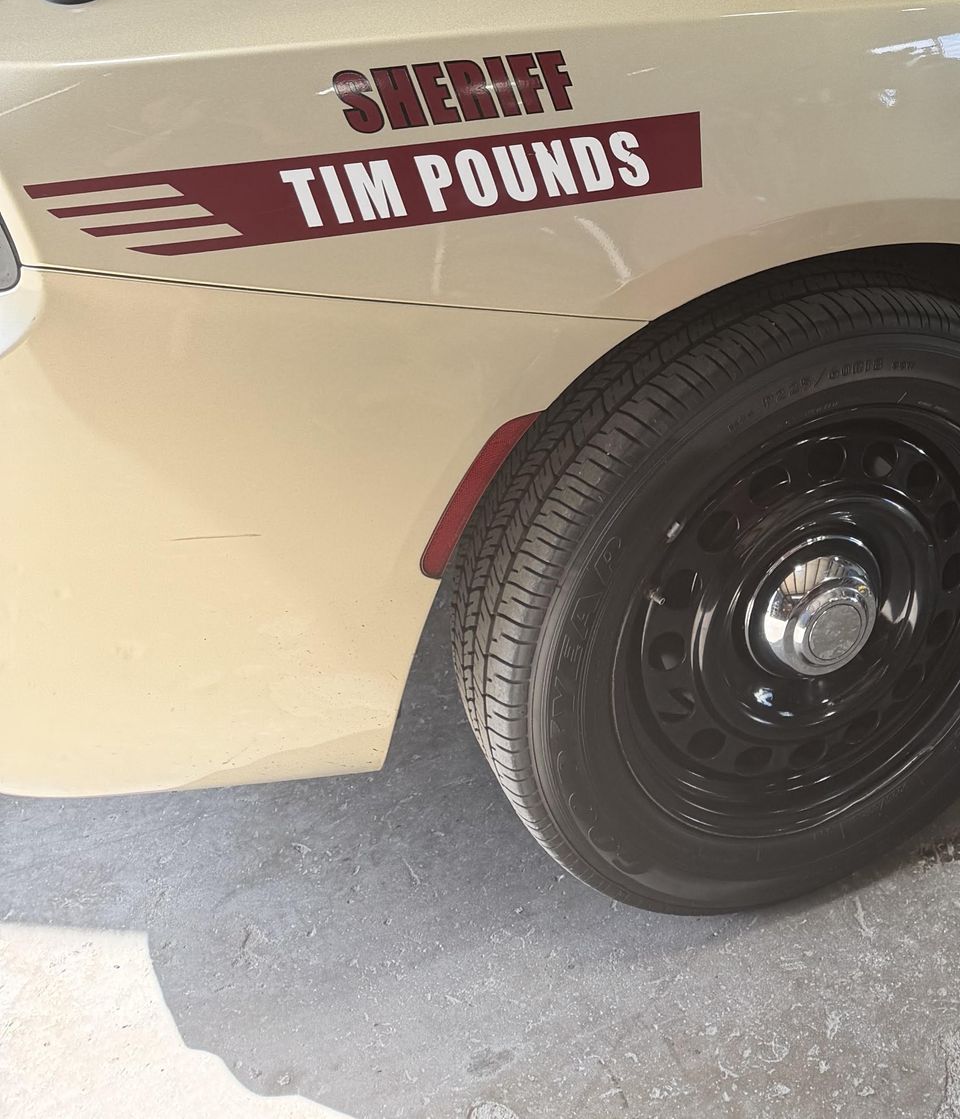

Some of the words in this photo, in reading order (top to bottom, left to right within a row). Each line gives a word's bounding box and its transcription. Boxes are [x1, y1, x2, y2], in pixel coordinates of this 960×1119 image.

[332, 49, 575, 135] SHERIFF
[279, 158, 408, 229] TIM
[413, 130, 651, 213] POUNDS
